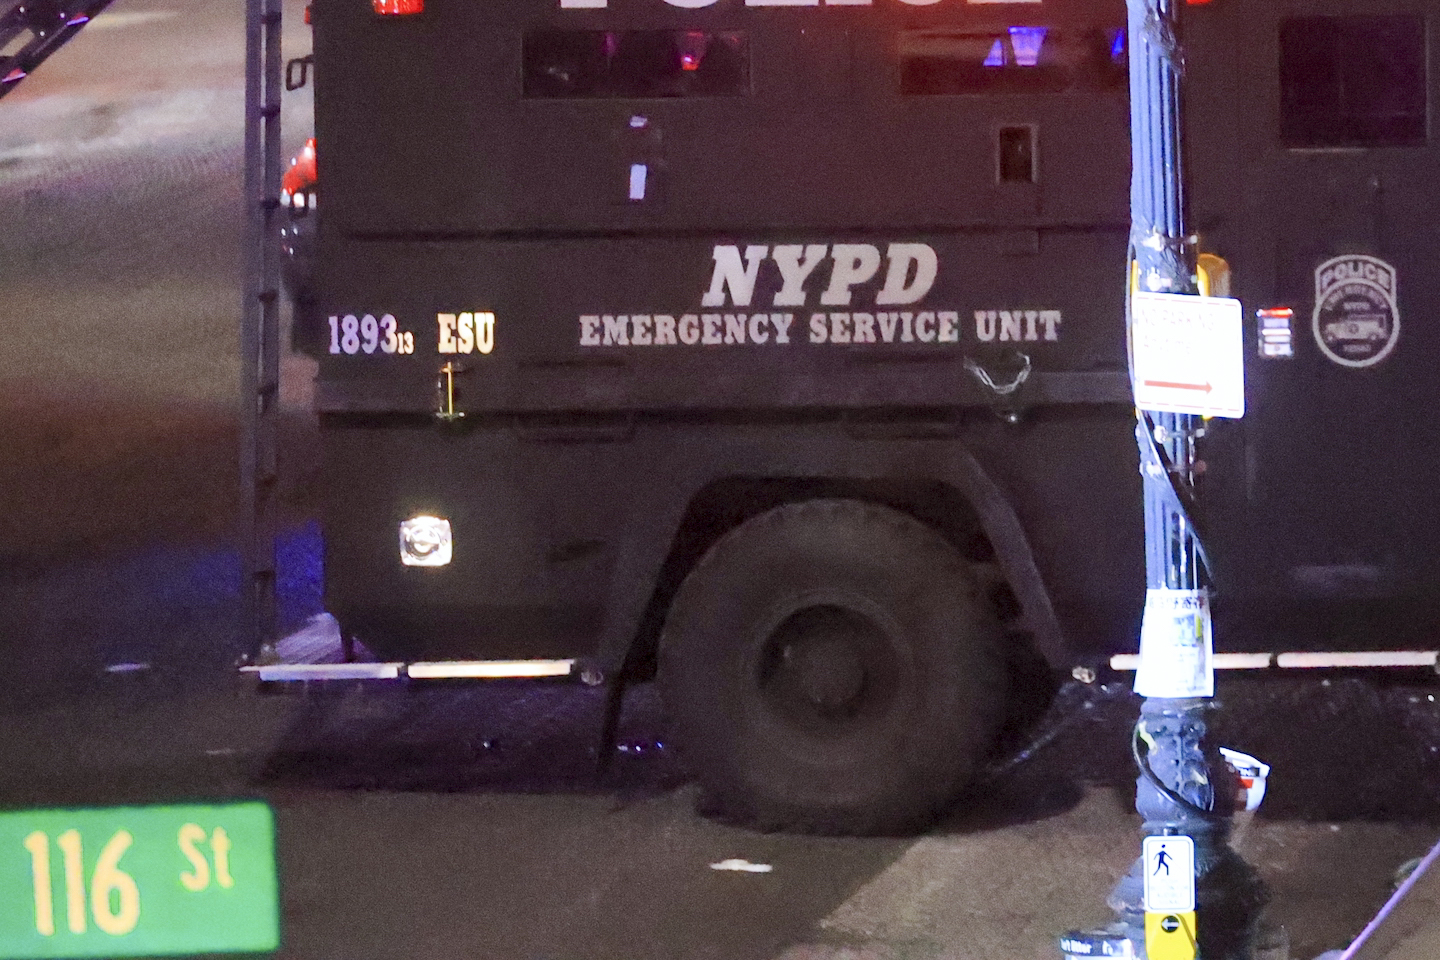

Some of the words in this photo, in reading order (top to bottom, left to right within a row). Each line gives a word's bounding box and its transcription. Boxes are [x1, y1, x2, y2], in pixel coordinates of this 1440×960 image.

[701, 243, 938, 306] NYPD
[1321, 261, 1390, 291] POLICE
[437, 312, 496, 355] ESU
[579, 313, 794, 346] EMERGENCY
[809, 312, 958, 343] SERVICE
[973, 310, 1062, 341] UNIT
[23, 828, 141, 936] 116
[176, 822, 235, 892] St
